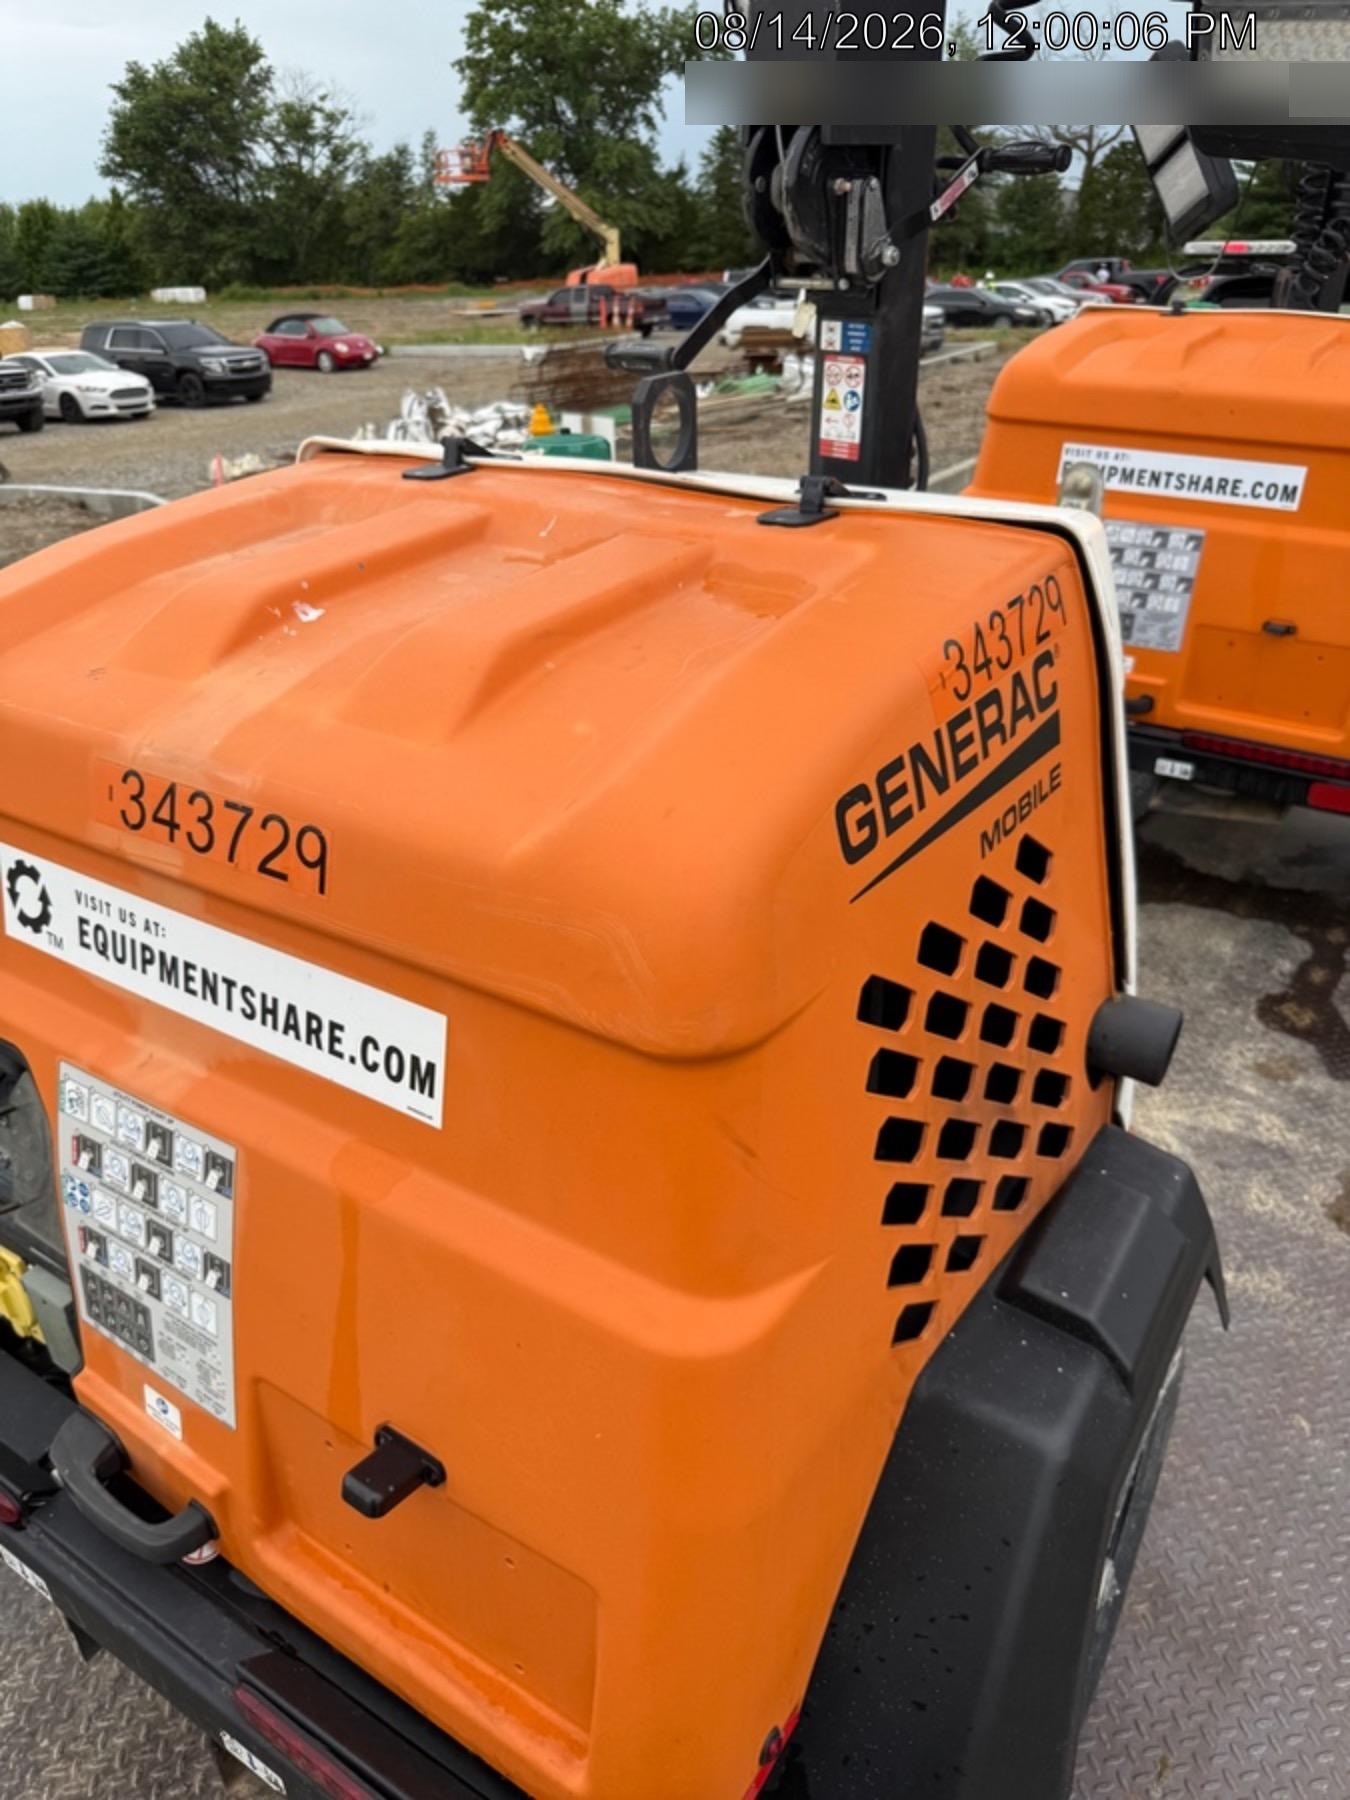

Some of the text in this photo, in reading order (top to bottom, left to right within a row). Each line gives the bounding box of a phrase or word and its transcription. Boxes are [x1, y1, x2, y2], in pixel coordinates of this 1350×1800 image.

[1061, 461, 1298, 504] EPMENTSHARE.COM
[834, 649, 1058, 866] GENERAC
[979, 763, 1062, 860] MOBILE
[74, 889, 166, 938] VISIT US AT:
[77, 916, 437, 1099] EQUIPMENTSHARE.COM
